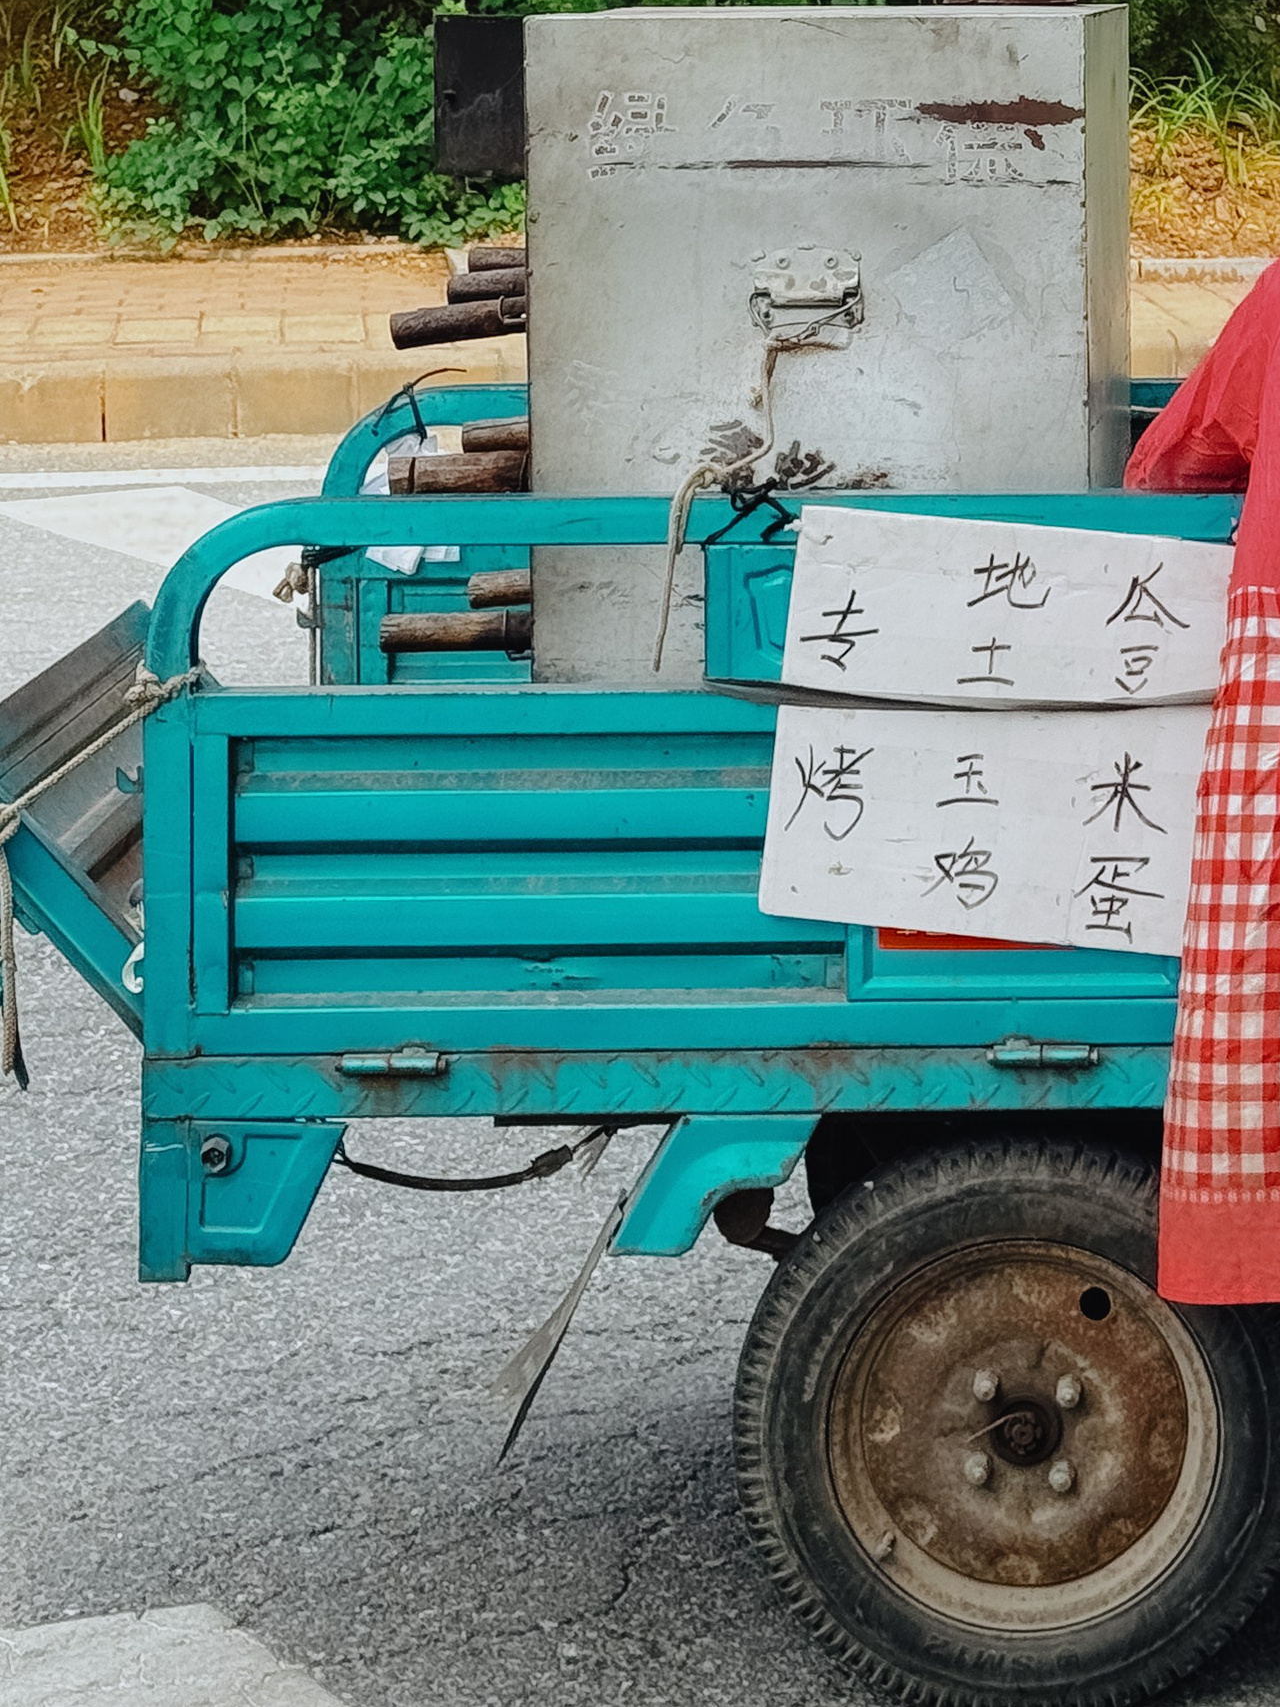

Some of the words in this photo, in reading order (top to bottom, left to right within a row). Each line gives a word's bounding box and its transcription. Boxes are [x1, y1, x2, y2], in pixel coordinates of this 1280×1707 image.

[785, 743, 876, 840] 烤
[936, 751, 1169, 835] 玉米
[920, 836, 1166, 945] 鸡蛋
